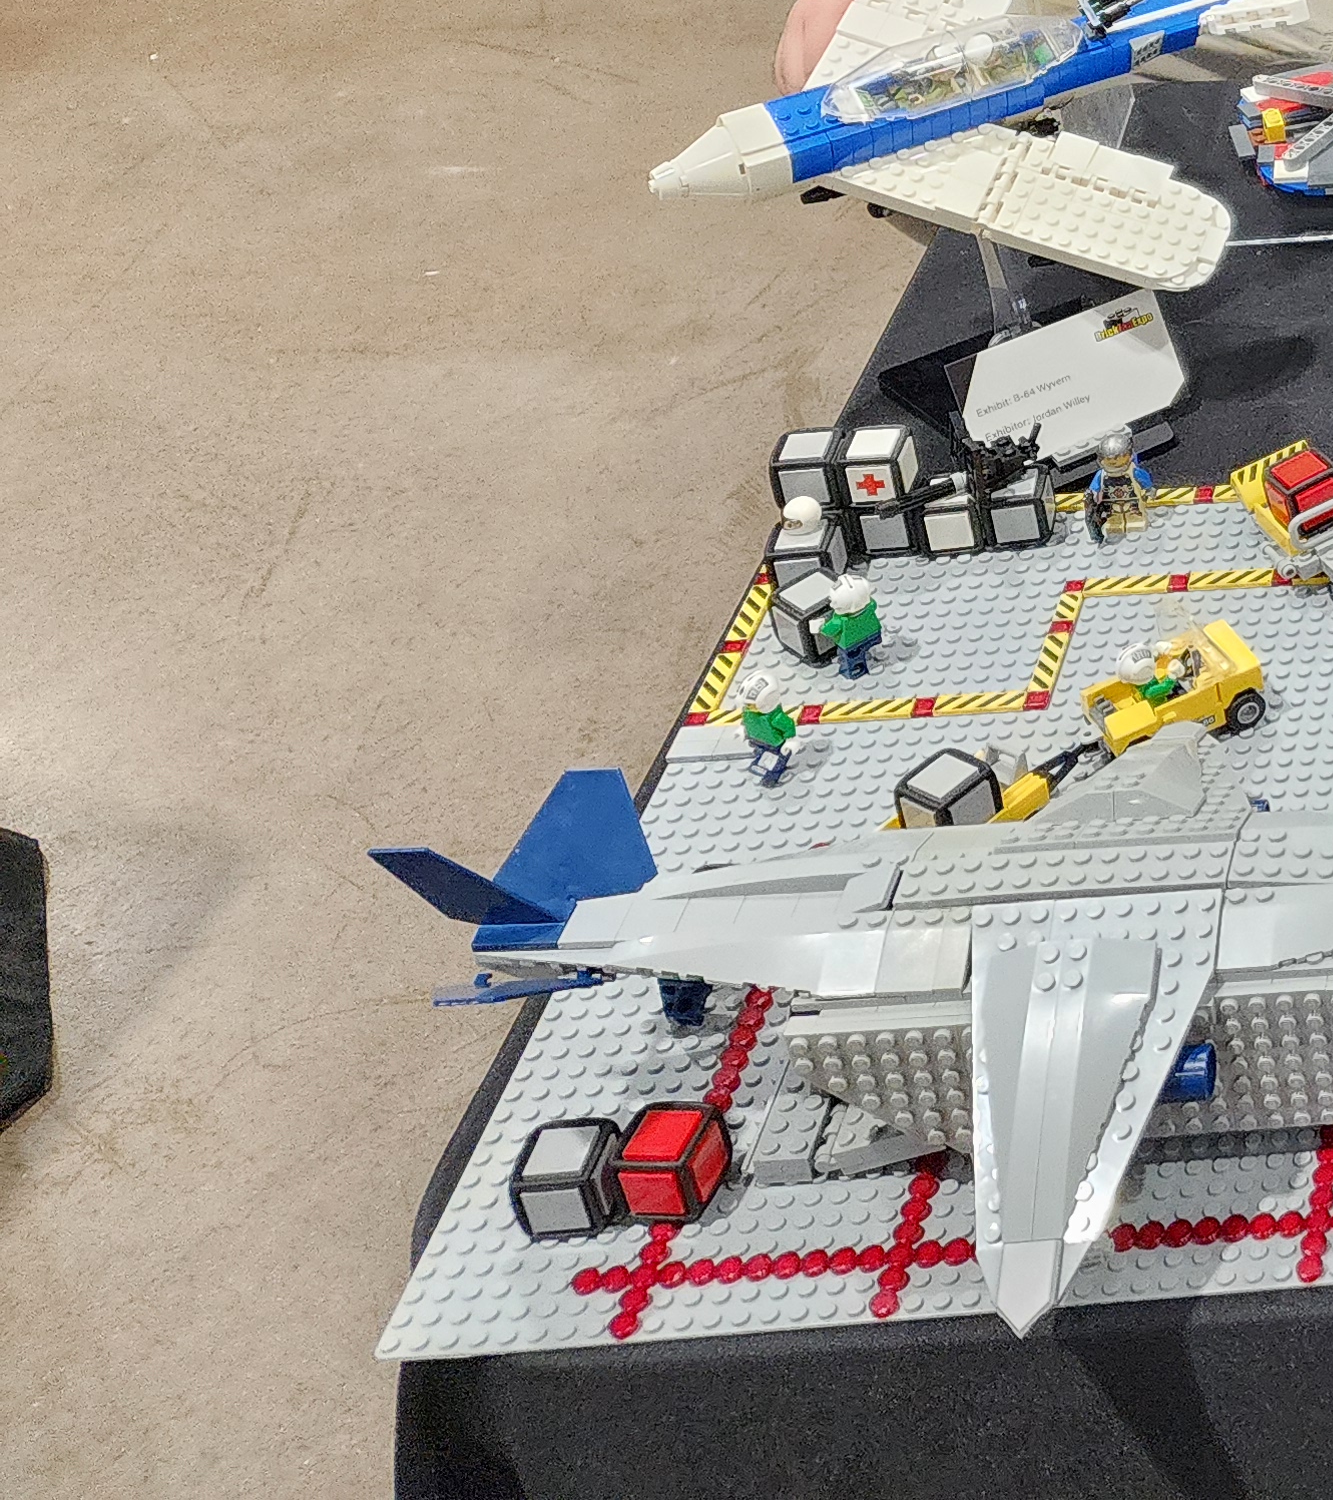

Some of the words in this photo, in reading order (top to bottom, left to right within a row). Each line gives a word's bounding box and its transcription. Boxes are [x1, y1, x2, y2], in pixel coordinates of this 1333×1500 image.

[975, 395, 1014, 419] Exhibit:
[1035, 373, 1072, 396] Wyvern
[1031, 405, 1064, 424] Jordan
[1062, 394, 1092, 412] Willey
